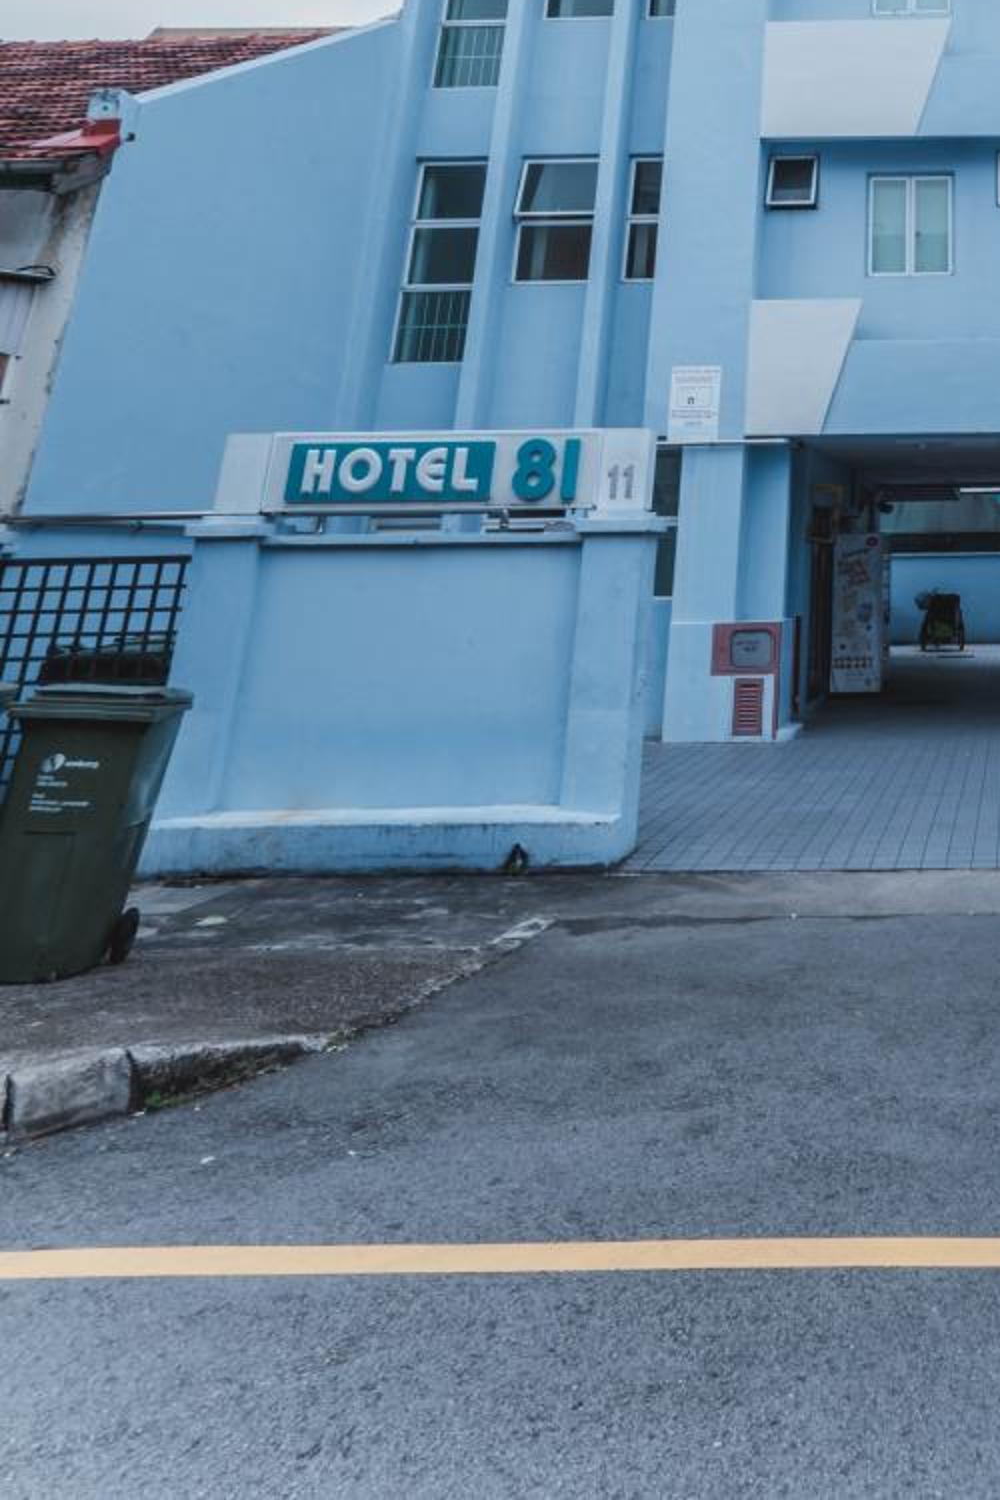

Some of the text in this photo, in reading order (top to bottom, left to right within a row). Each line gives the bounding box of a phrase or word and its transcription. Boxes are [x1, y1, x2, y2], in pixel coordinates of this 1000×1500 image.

[301, 438, 581, 501] HOTEL 81
[607, 463, 636, 500] 11
